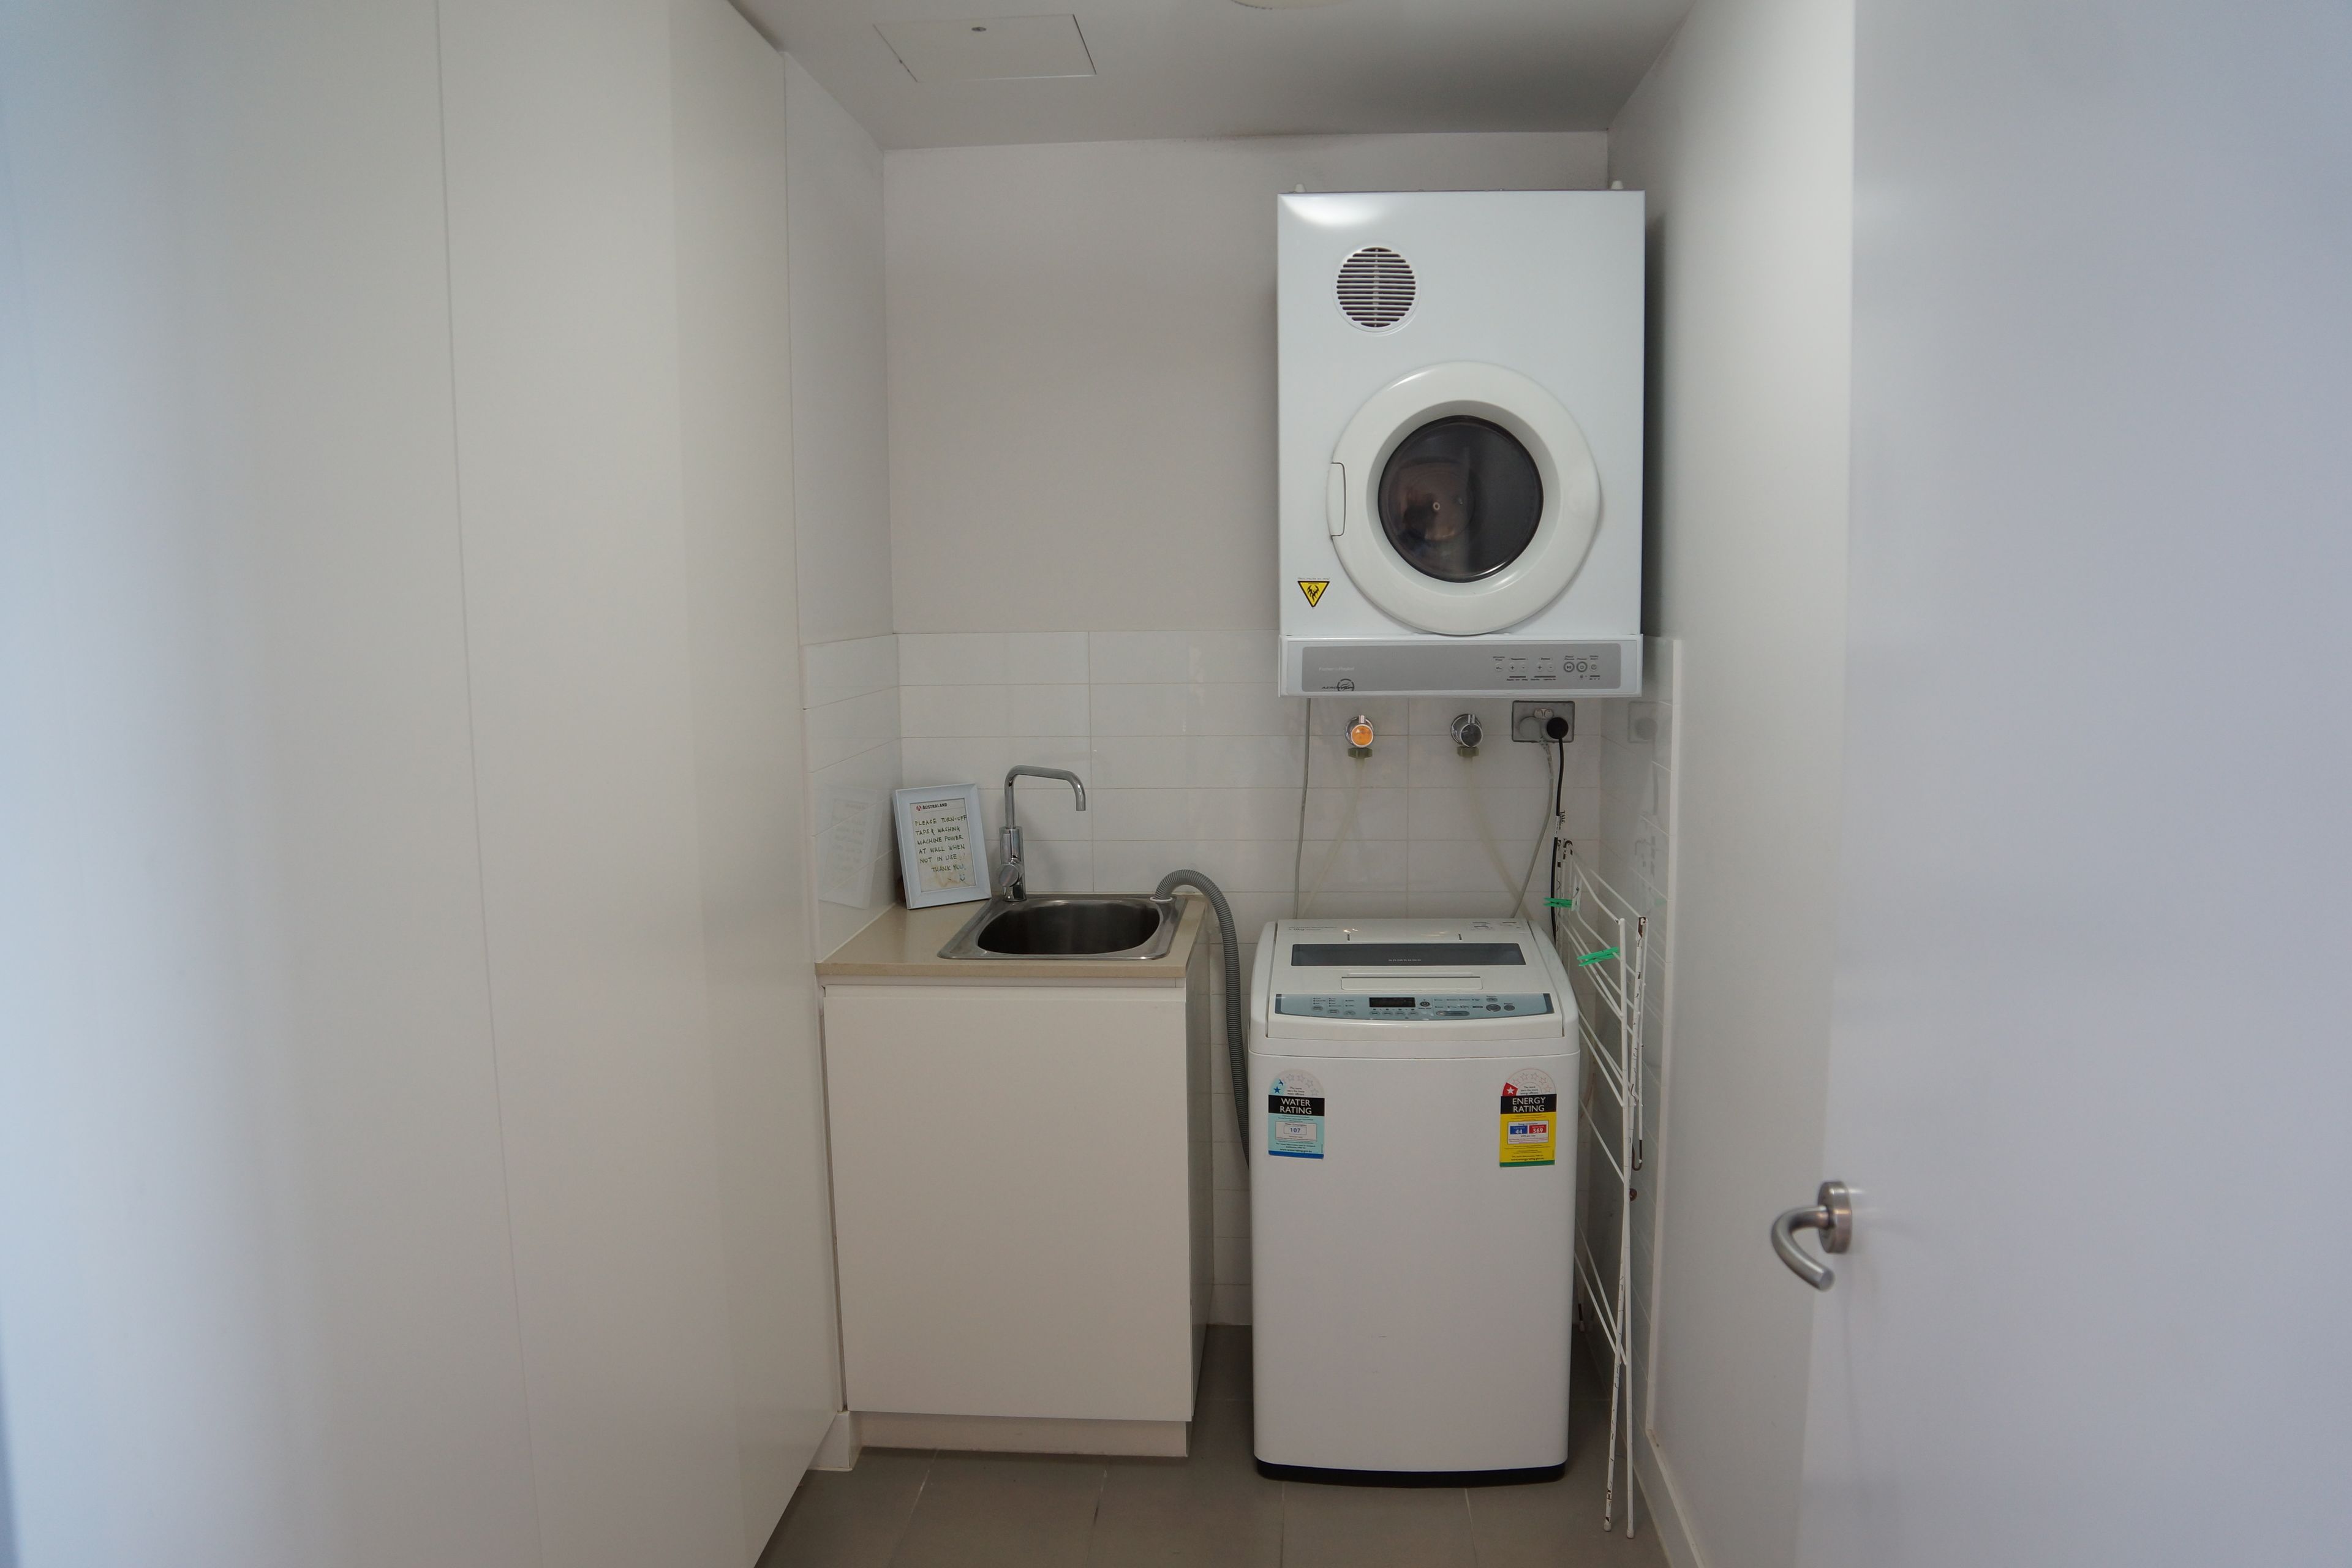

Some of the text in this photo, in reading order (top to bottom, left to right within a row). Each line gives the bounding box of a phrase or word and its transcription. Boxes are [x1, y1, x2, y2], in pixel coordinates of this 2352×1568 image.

[1281, 1098, 1311, 1106] WATER
[1512, 1096, 1546, 1105] ENERGY
[1280, 1106, 1312, 1114] RATING
